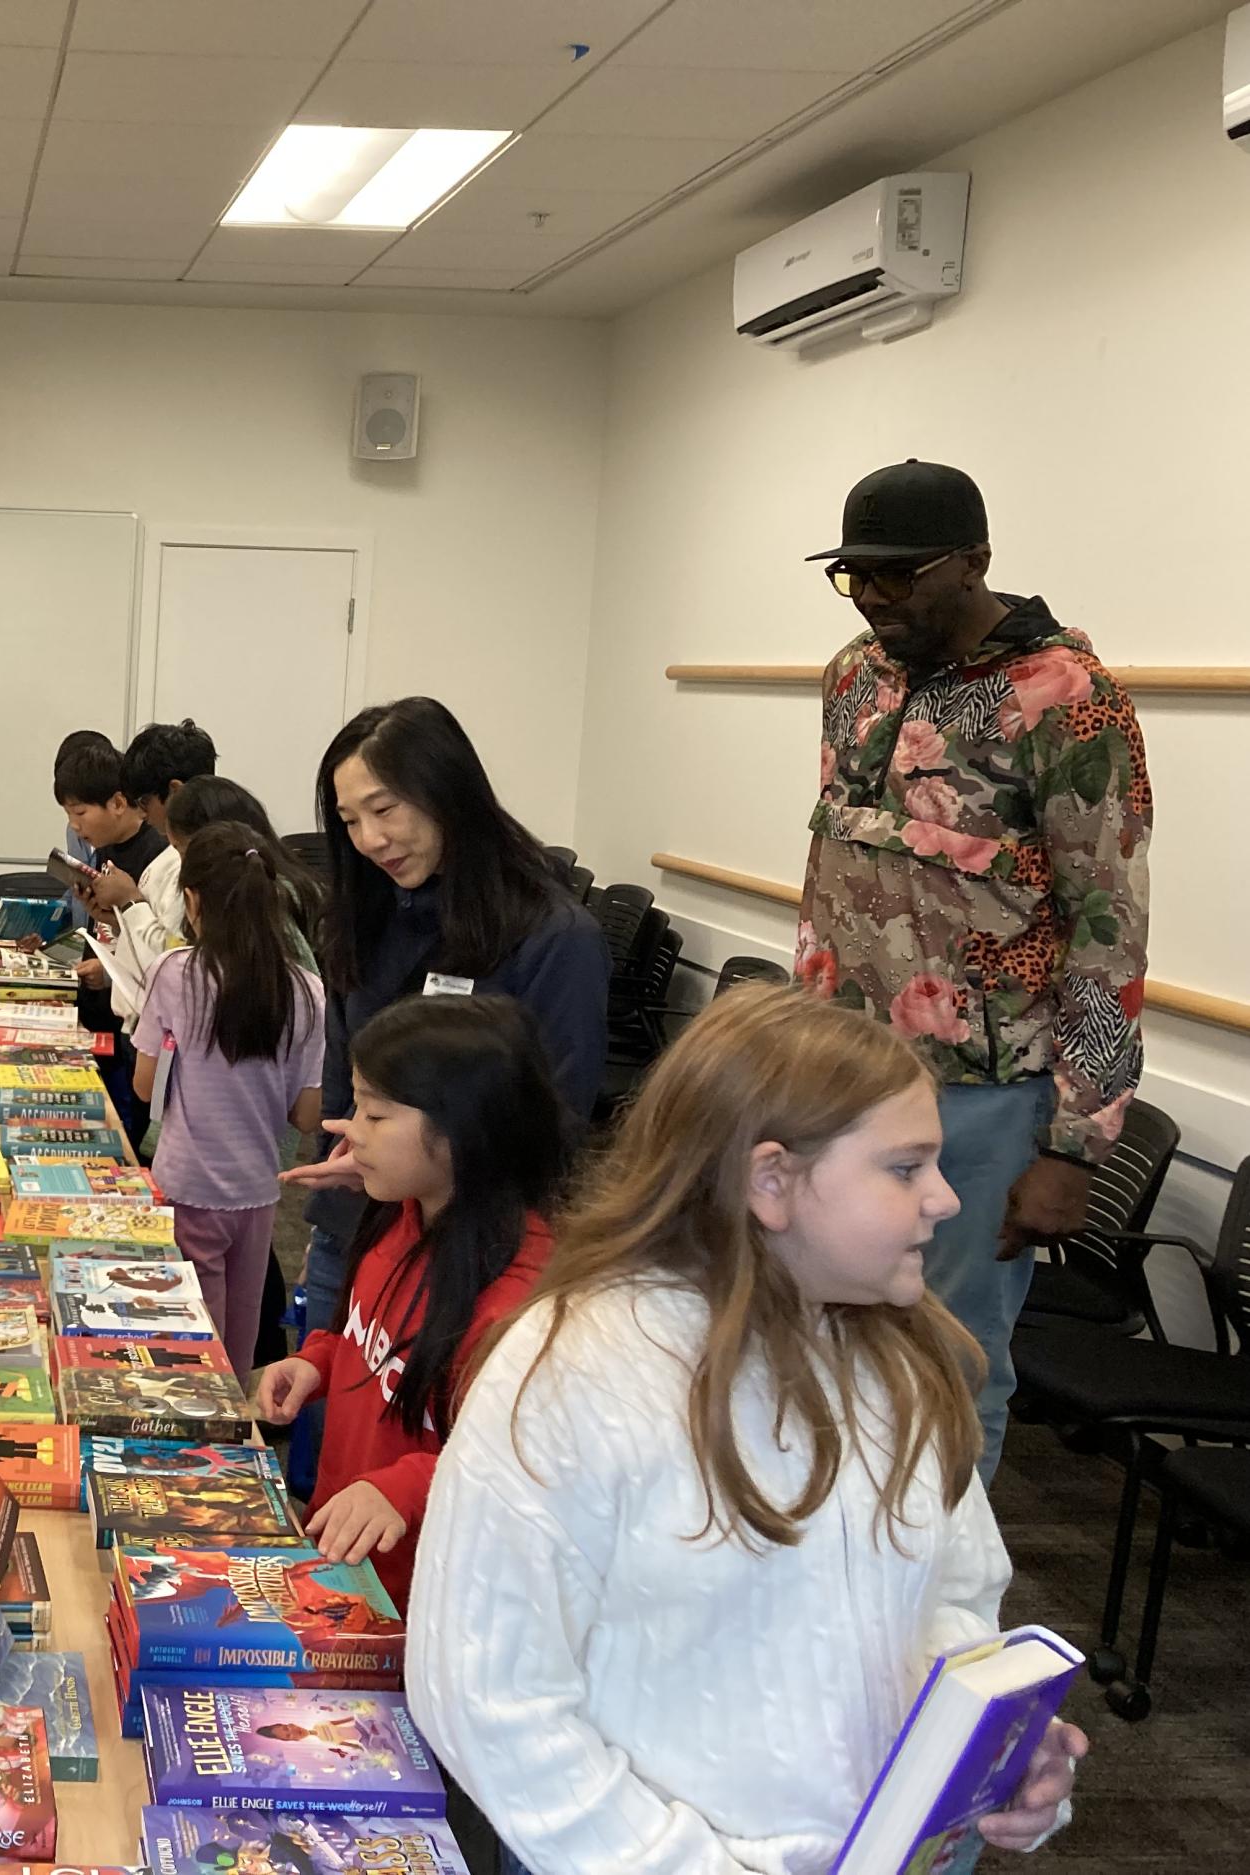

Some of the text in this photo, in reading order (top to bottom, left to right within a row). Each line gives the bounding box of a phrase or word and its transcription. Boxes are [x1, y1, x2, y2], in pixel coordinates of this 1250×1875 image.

[131, 1416, 178, 1433] Gather
[26, 1482, 53, 1492] EXAM
[26, 1496, 53, 1504] EXAM
[227, 1556, 284, 1623] IMPOSSIBLE
[218, 1646, 379, 1670] IMPOSSIBLE CREATURES
[183, 1691, 218, 1733] ENGLE
[390, 1706, 420, 1747] JOHNSON
[21, 1734, 35, 1803] ELIZABETH
[226, 1743, 248, 1774] SAVES
[241, 1797, 274, 1810] ENGLE
[275, 1800, 305, 1811] SAVES
[308, 1802, 326, 1811] THE
